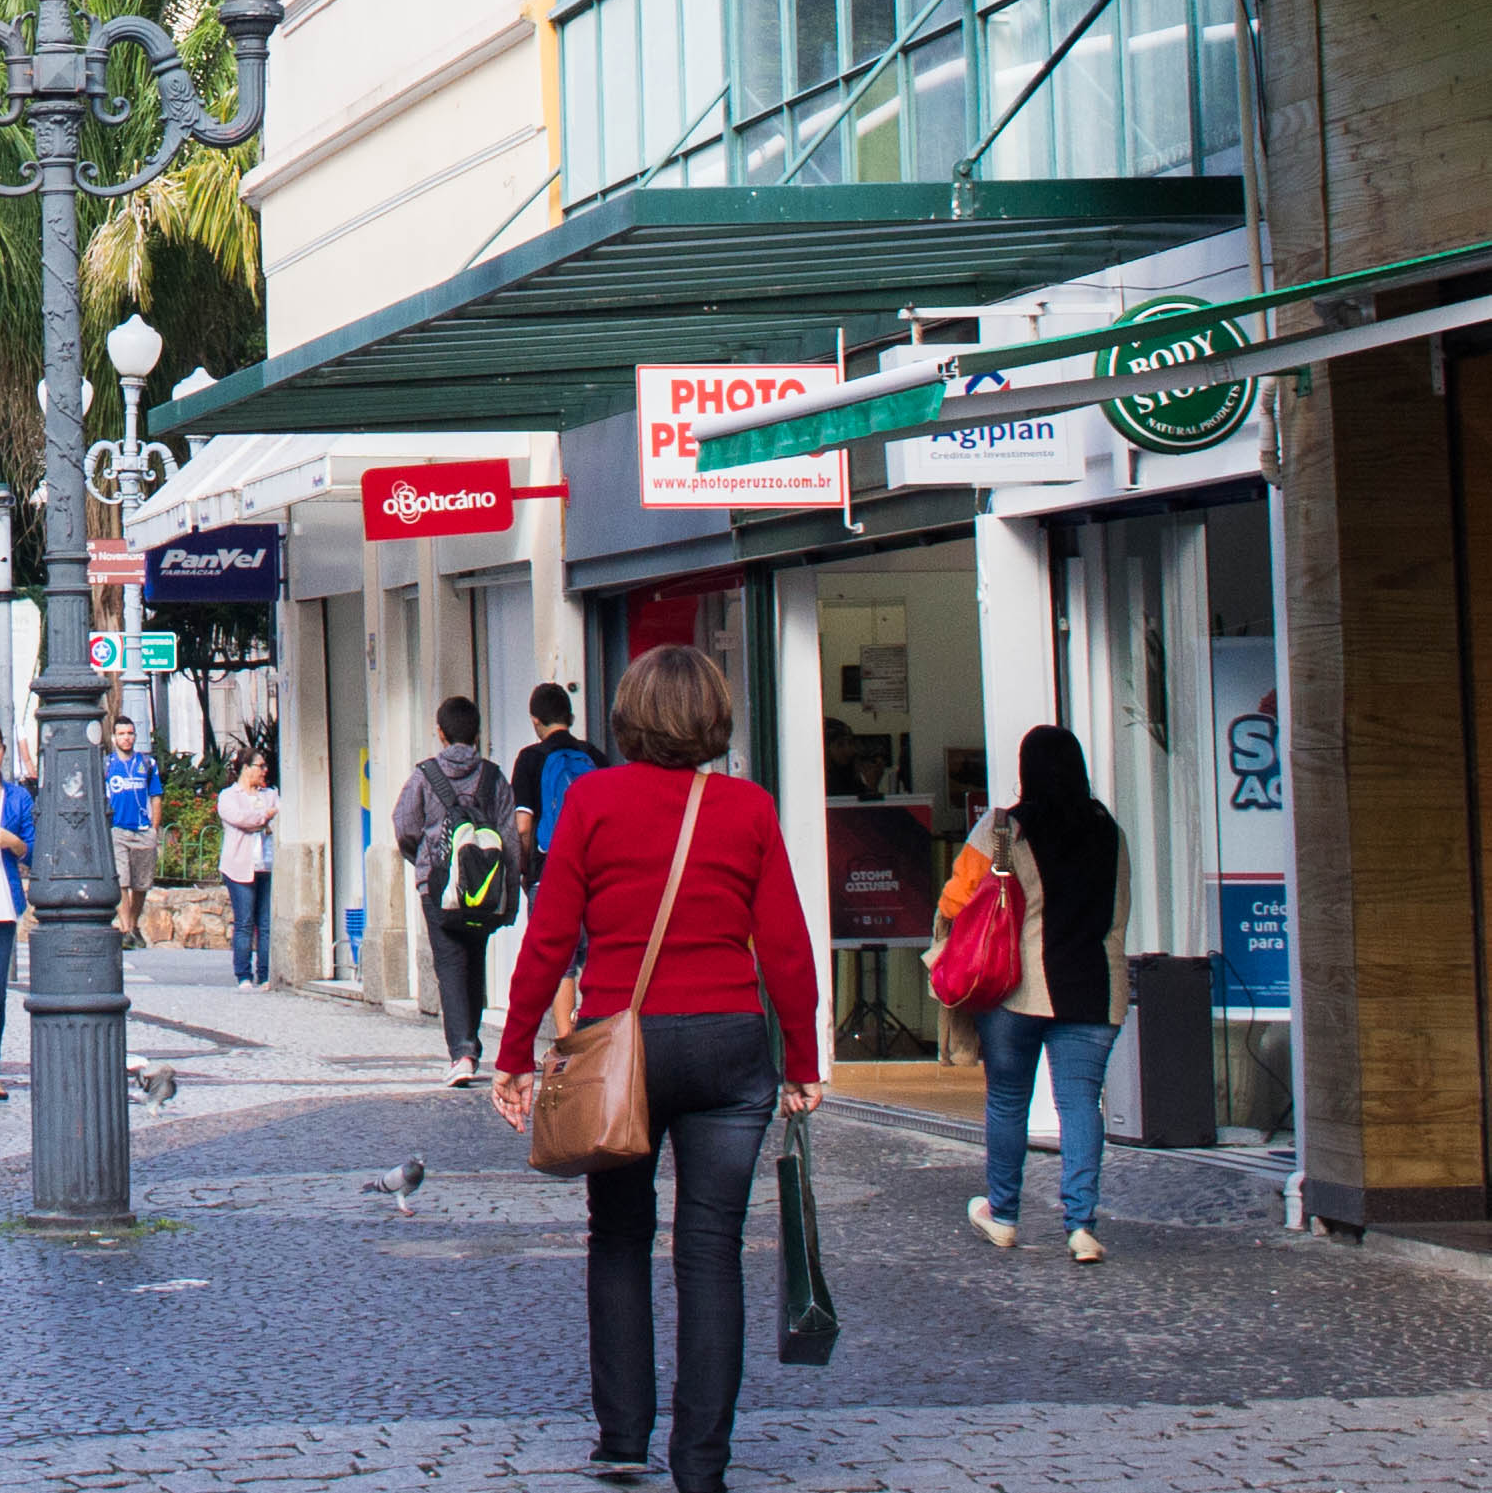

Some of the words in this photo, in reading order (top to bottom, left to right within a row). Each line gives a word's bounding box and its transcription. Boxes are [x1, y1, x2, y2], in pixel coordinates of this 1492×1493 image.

[1146, 416, 1200, 436] NATURAL
[1200, 384, 1241, 432] PRODUCTS
[983, 450, 1055, 459] Investimento
[652, 474, 832, 494] www.photoperuzzo.com.br
[1248, 937, 1285, 952] para
